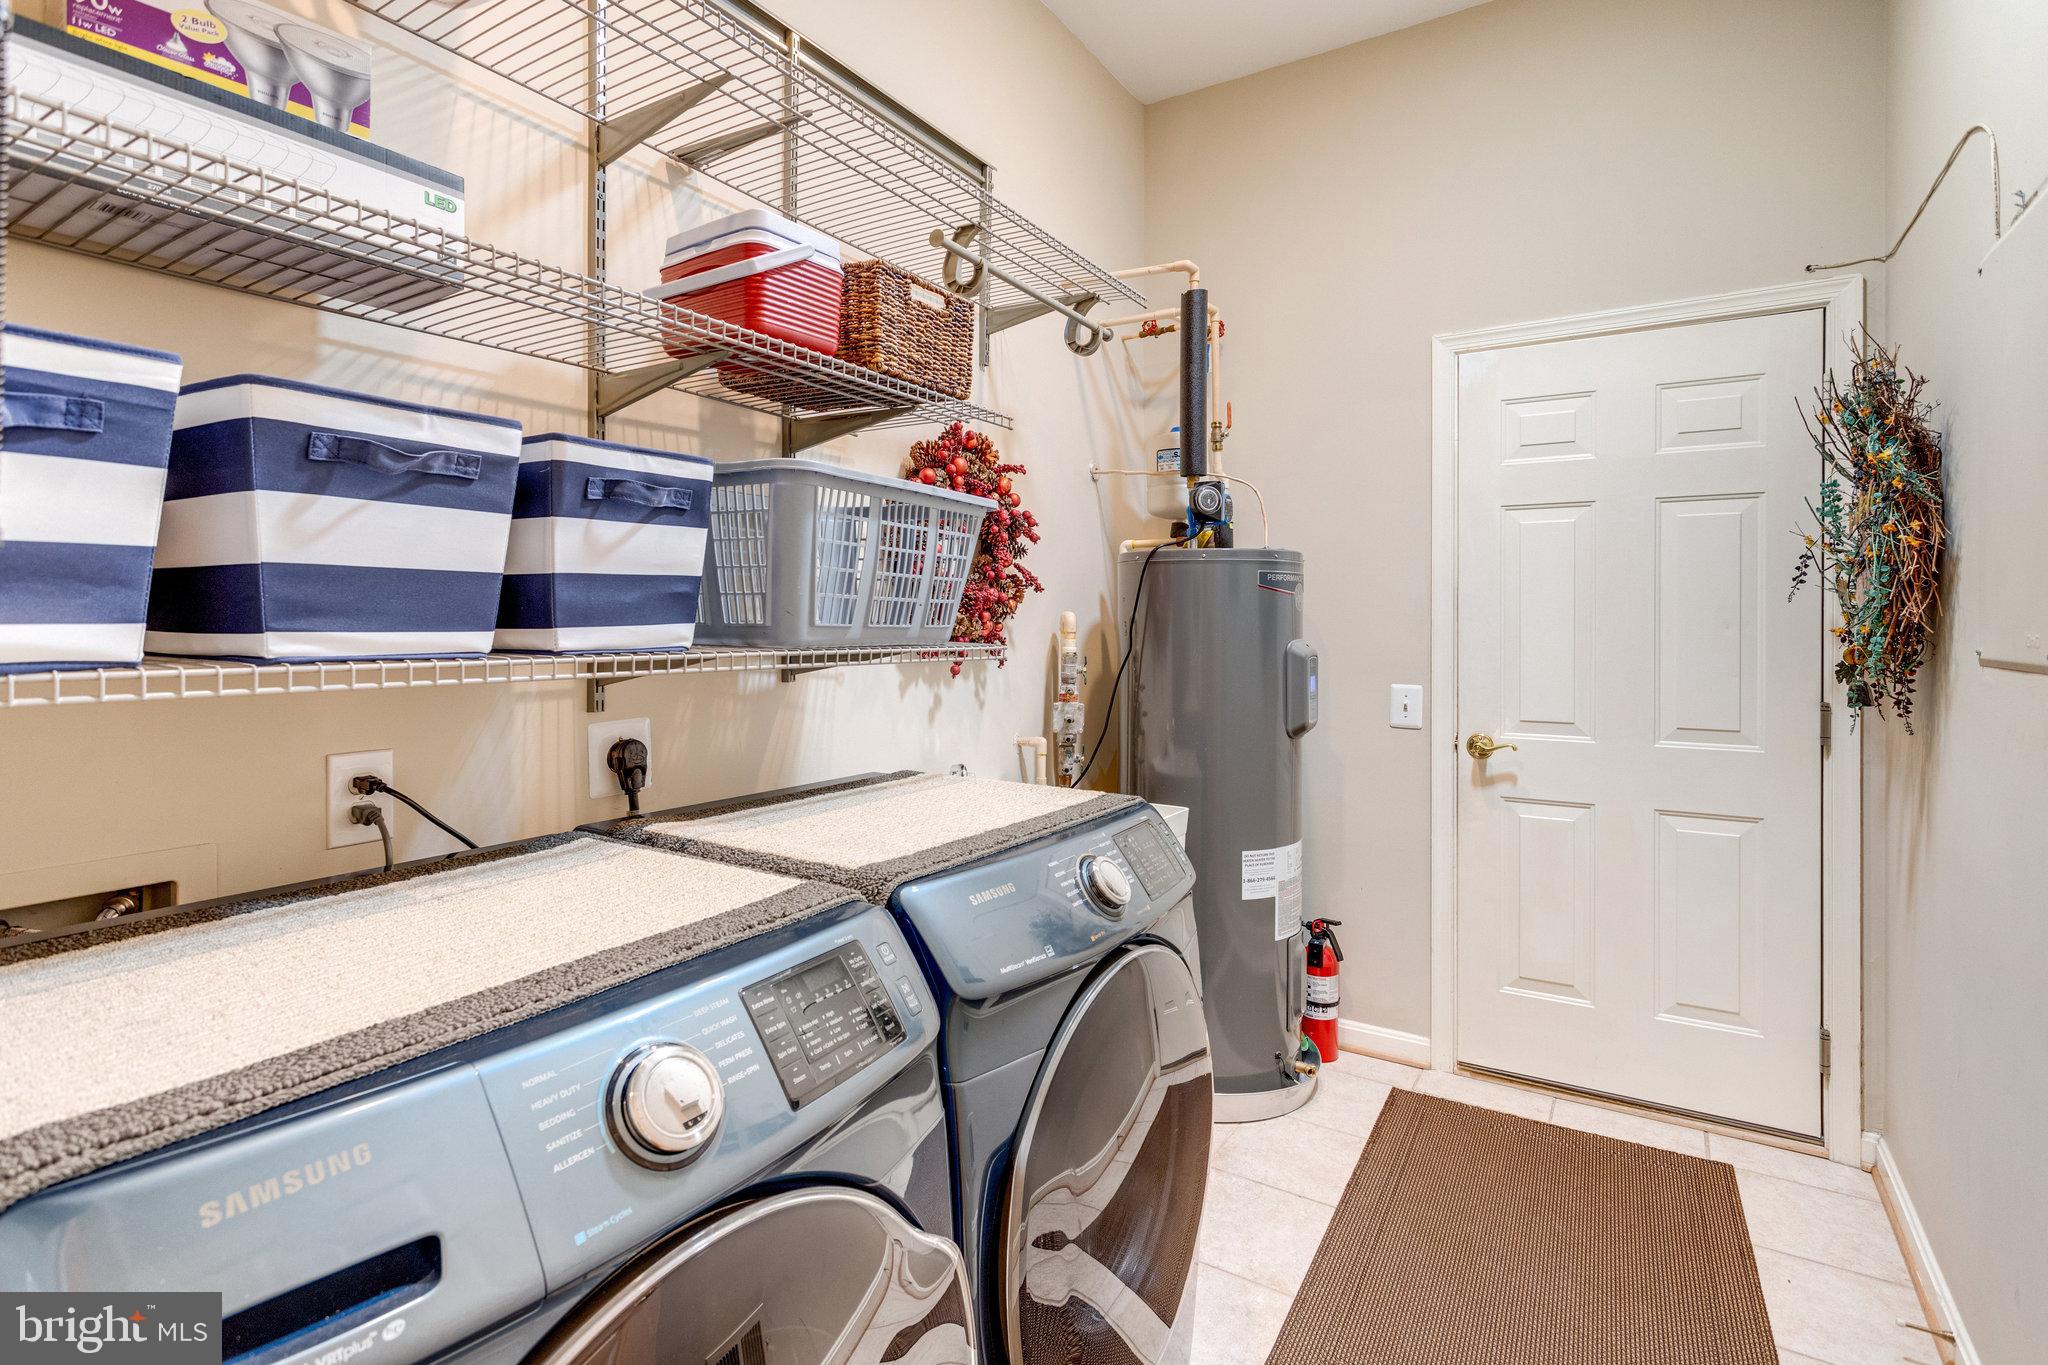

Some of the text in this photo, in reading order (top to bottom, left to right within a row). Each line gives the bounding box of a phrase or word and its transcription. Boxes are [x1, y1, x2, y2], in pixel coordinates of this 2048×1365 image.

[94, 23, 117, 37] LED
[181, 14, 216, 29] 2 Bulb
[424, 190, 457, 214] LED
[968, 882, 1016, 906] SAMSUNG
[701, 1014, 738, 1036] QUICK WASH
[714, 1030, 745, 1049] DELICATES
[718, 1047, 753, 1068] PERM PRESS
[522, 1069, 559, 1089] NORMAL
[530, 1082, 581, 1112] HEAVY DUTY
[538, 1108, 577, 1132] BEDDING
[545, 1128, 584, 1152] SANITIZE
[553, 1146, 596, 1174] ALLERGEN
[198, 1141, 374, 1229] SAMSUNG
